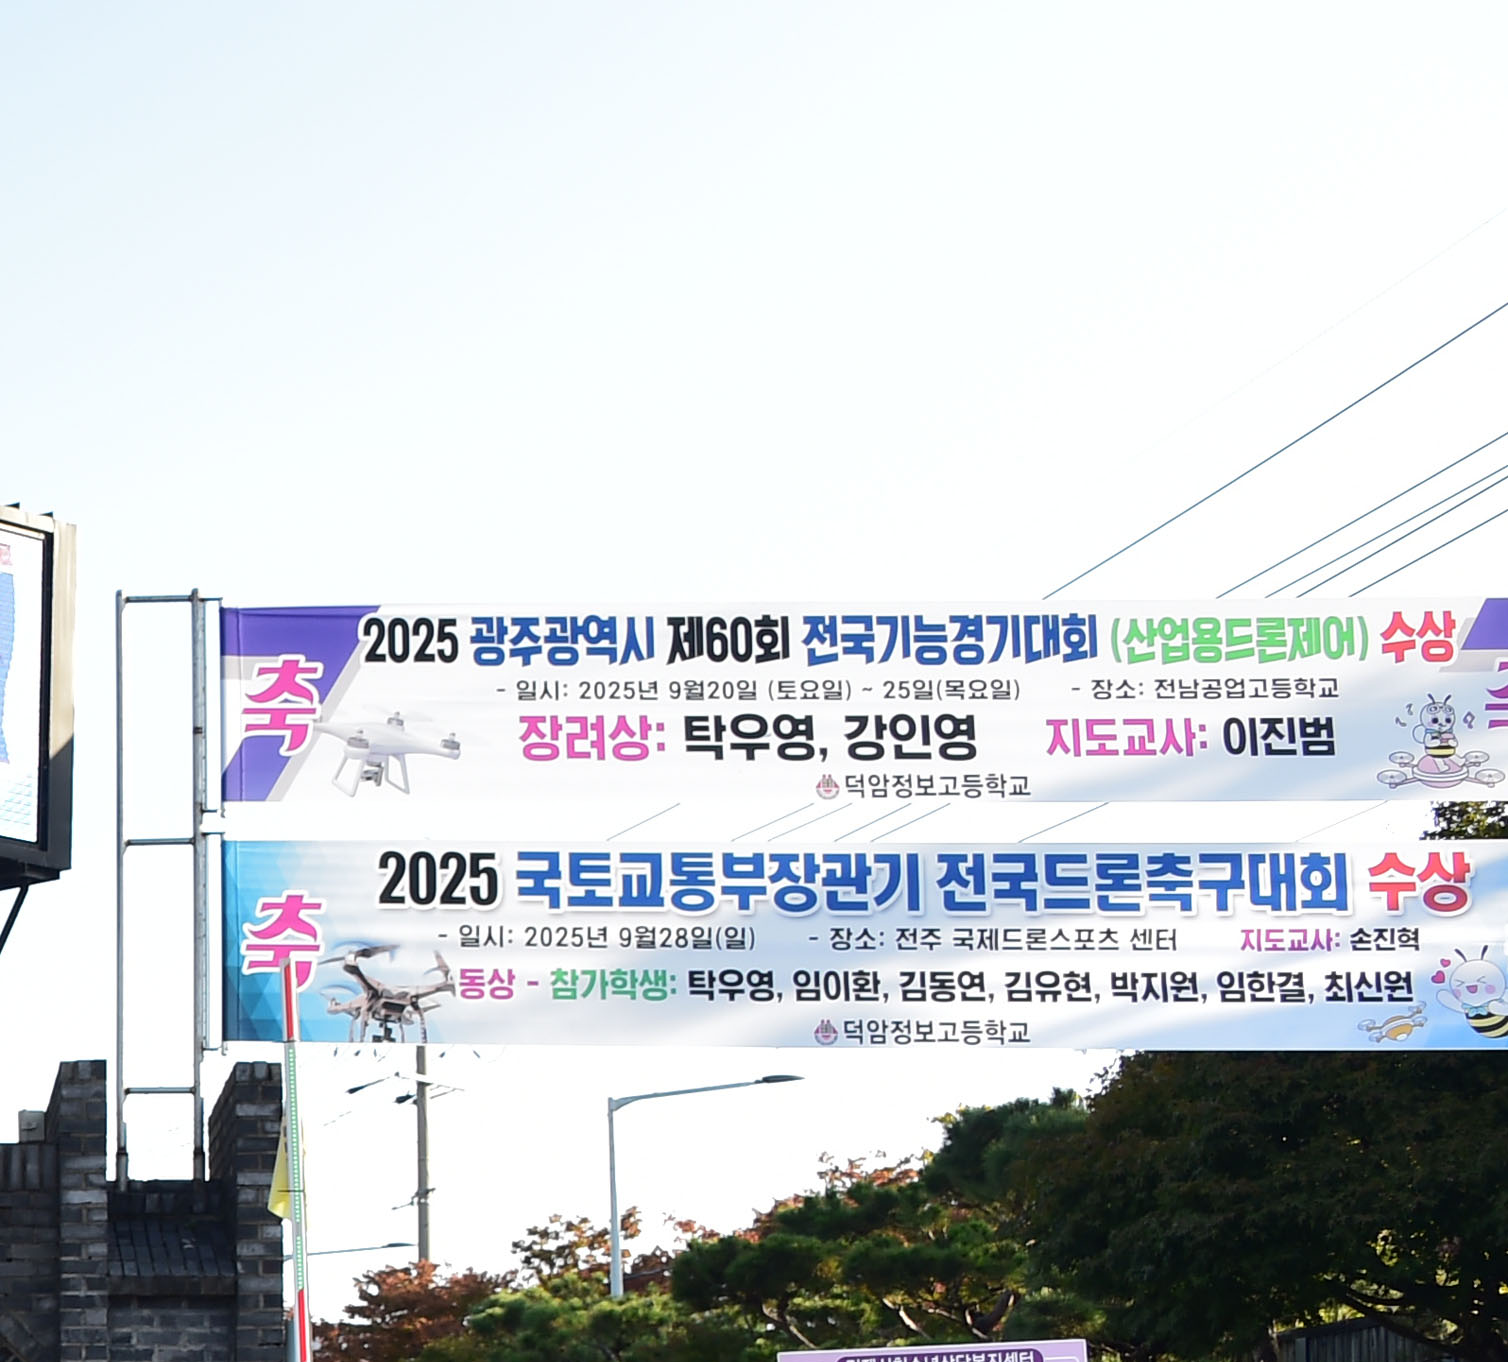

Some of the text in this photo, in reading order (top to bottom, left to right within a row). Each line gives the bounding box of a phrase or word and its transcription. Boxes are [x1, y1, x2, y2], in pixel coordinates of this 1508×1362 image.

[363, 610, 1457, 667] 2025 광주광역시 제60회 전국기능경기대회 (산업용드론제어) 수상
[245, 660, 319, 752] 축
[516, 680, 568, 701] 일시:
[579, 680, 658, 700] 2025년
[669, 679, 757, 701] 9월20일
[768, 679, 852, 701] (토요일)
[883, 679, 1020, 701] 25일(목요일)
[1090, 679, 1143, 700] 장소:
[1154, 678, 1340, 700] 전남공업고등학교
[519, 713, 1336, 762] 장려상: 탁우영, 강인영 지도교사: 이진범
[845, 773, 1032, 798] 덕암정보고등학교
[378, 850, 1471, 912] 2025 국토교통부장관기 전국드론축구대회 수상
[246, 894, 320, 988] 축
[459, 925, 514, 948] 일시:
[524, 926, 608, 948] 2025년
[619, 926, 755, 950] 9월28일(일)
[830, 927, 885, 950] 장소:
[895, 928, 942, 950] 전주
[953, 928, 1119, 951] 국제드론스포츠
[1129, 927, 1178, 951] 센터
[1240, 928, 1341, 951] 지도교사:
[1350, 927, 1420, 951] 손진혁
[459, 968, 516, 1000] 동상
[550, 968, 676, 1001] 참가학생:
[688, 969, 783, 1002] 탁우영,
[793, 969, 889, 1003] 임이환,
[899, 970, 994, 1003] 김동연,
[1004, 970, 1100, 1003] 김유현,
[1111, 971, 1207, 1004] 박지원,
[1216, 971, 1314, 1004] 임한결,
[1324, 971, 1414, 1002] 최신원
[844, 1019, 1031, 1045] 덕암정보고등학교
